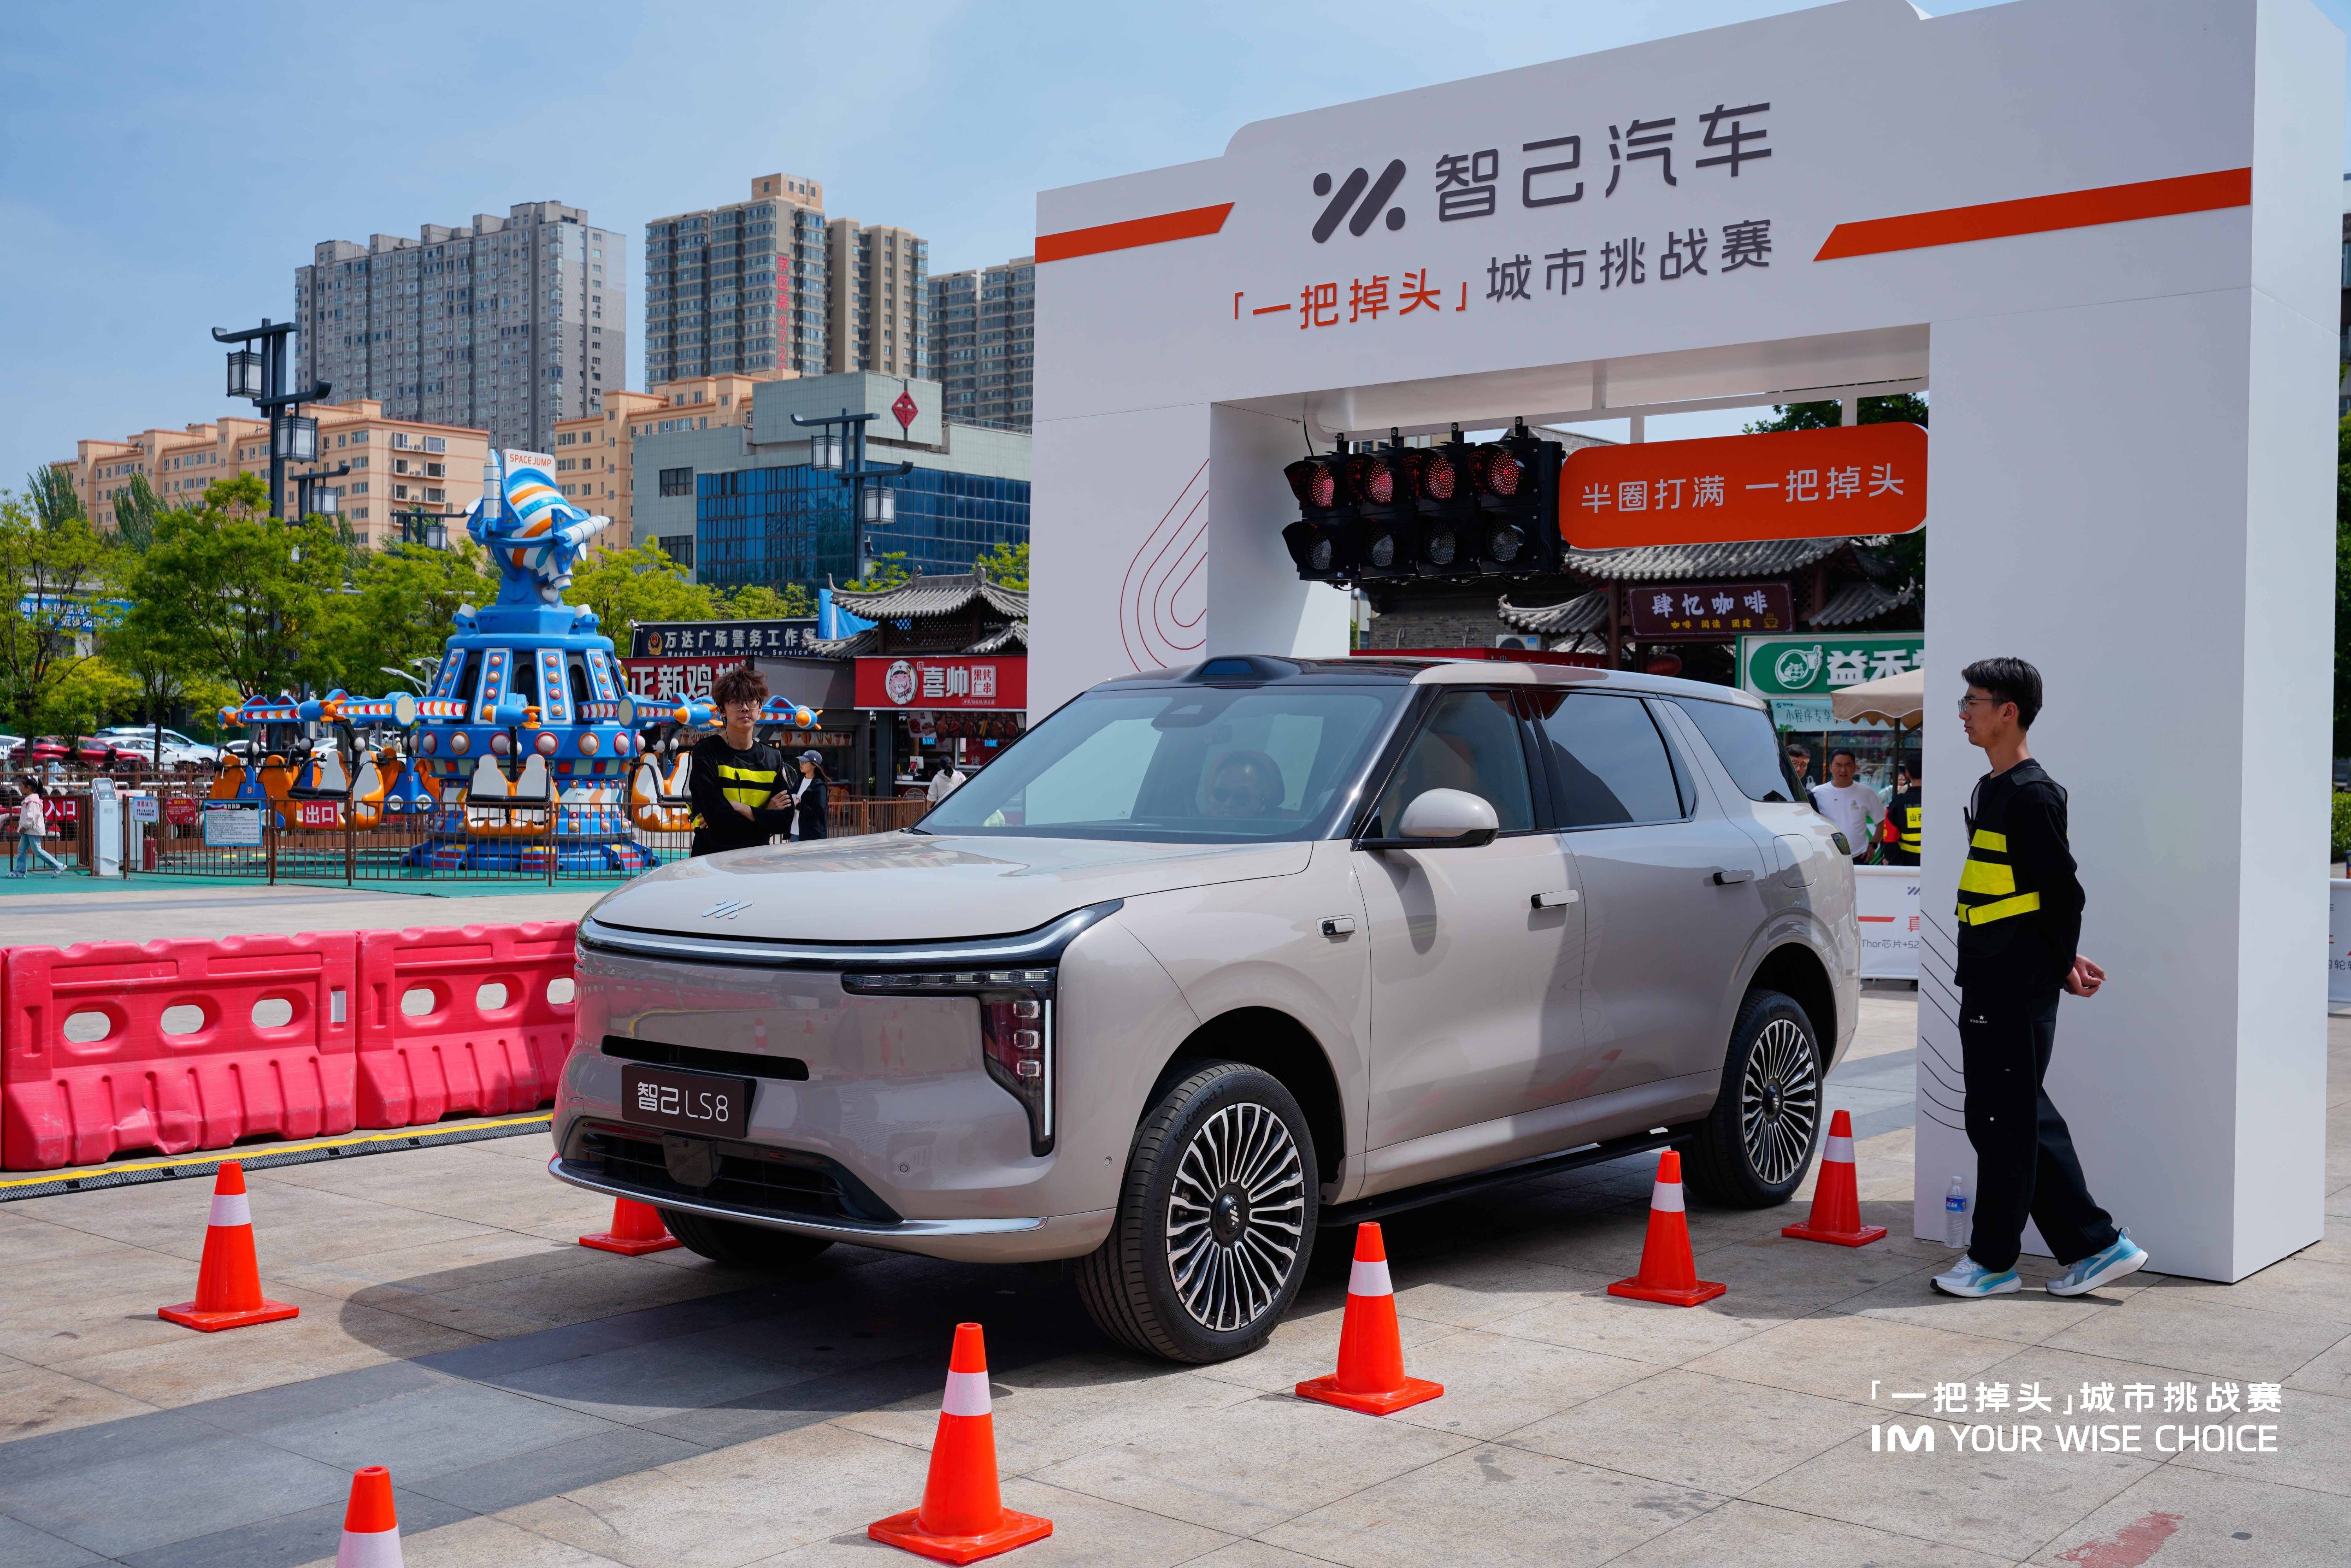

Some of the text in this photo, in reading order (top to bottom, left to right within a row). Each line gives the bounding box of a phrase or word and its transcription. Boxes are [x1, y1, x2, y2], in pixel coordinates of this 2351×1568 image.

[1435, 102, 1772, 222] 智己汽车
[510, 454, 551, 467] SPACE JUMP
[1581, 463, 1904, 514] 半圈打满 一把掉头
[1652, 589, 1768, 618] 肆忆咖啡
[1671, 618, 1751, 629] 咖啡 阅读 团建
[923, 666, 969, 697] 喜帅
[1827, 648, 1924, 685] 益禾
[45, 799, 76, 817] 入口
[306, 805, 334, 824] 出口
[1174, 1085, 1224, 1143] EcoContact 7
